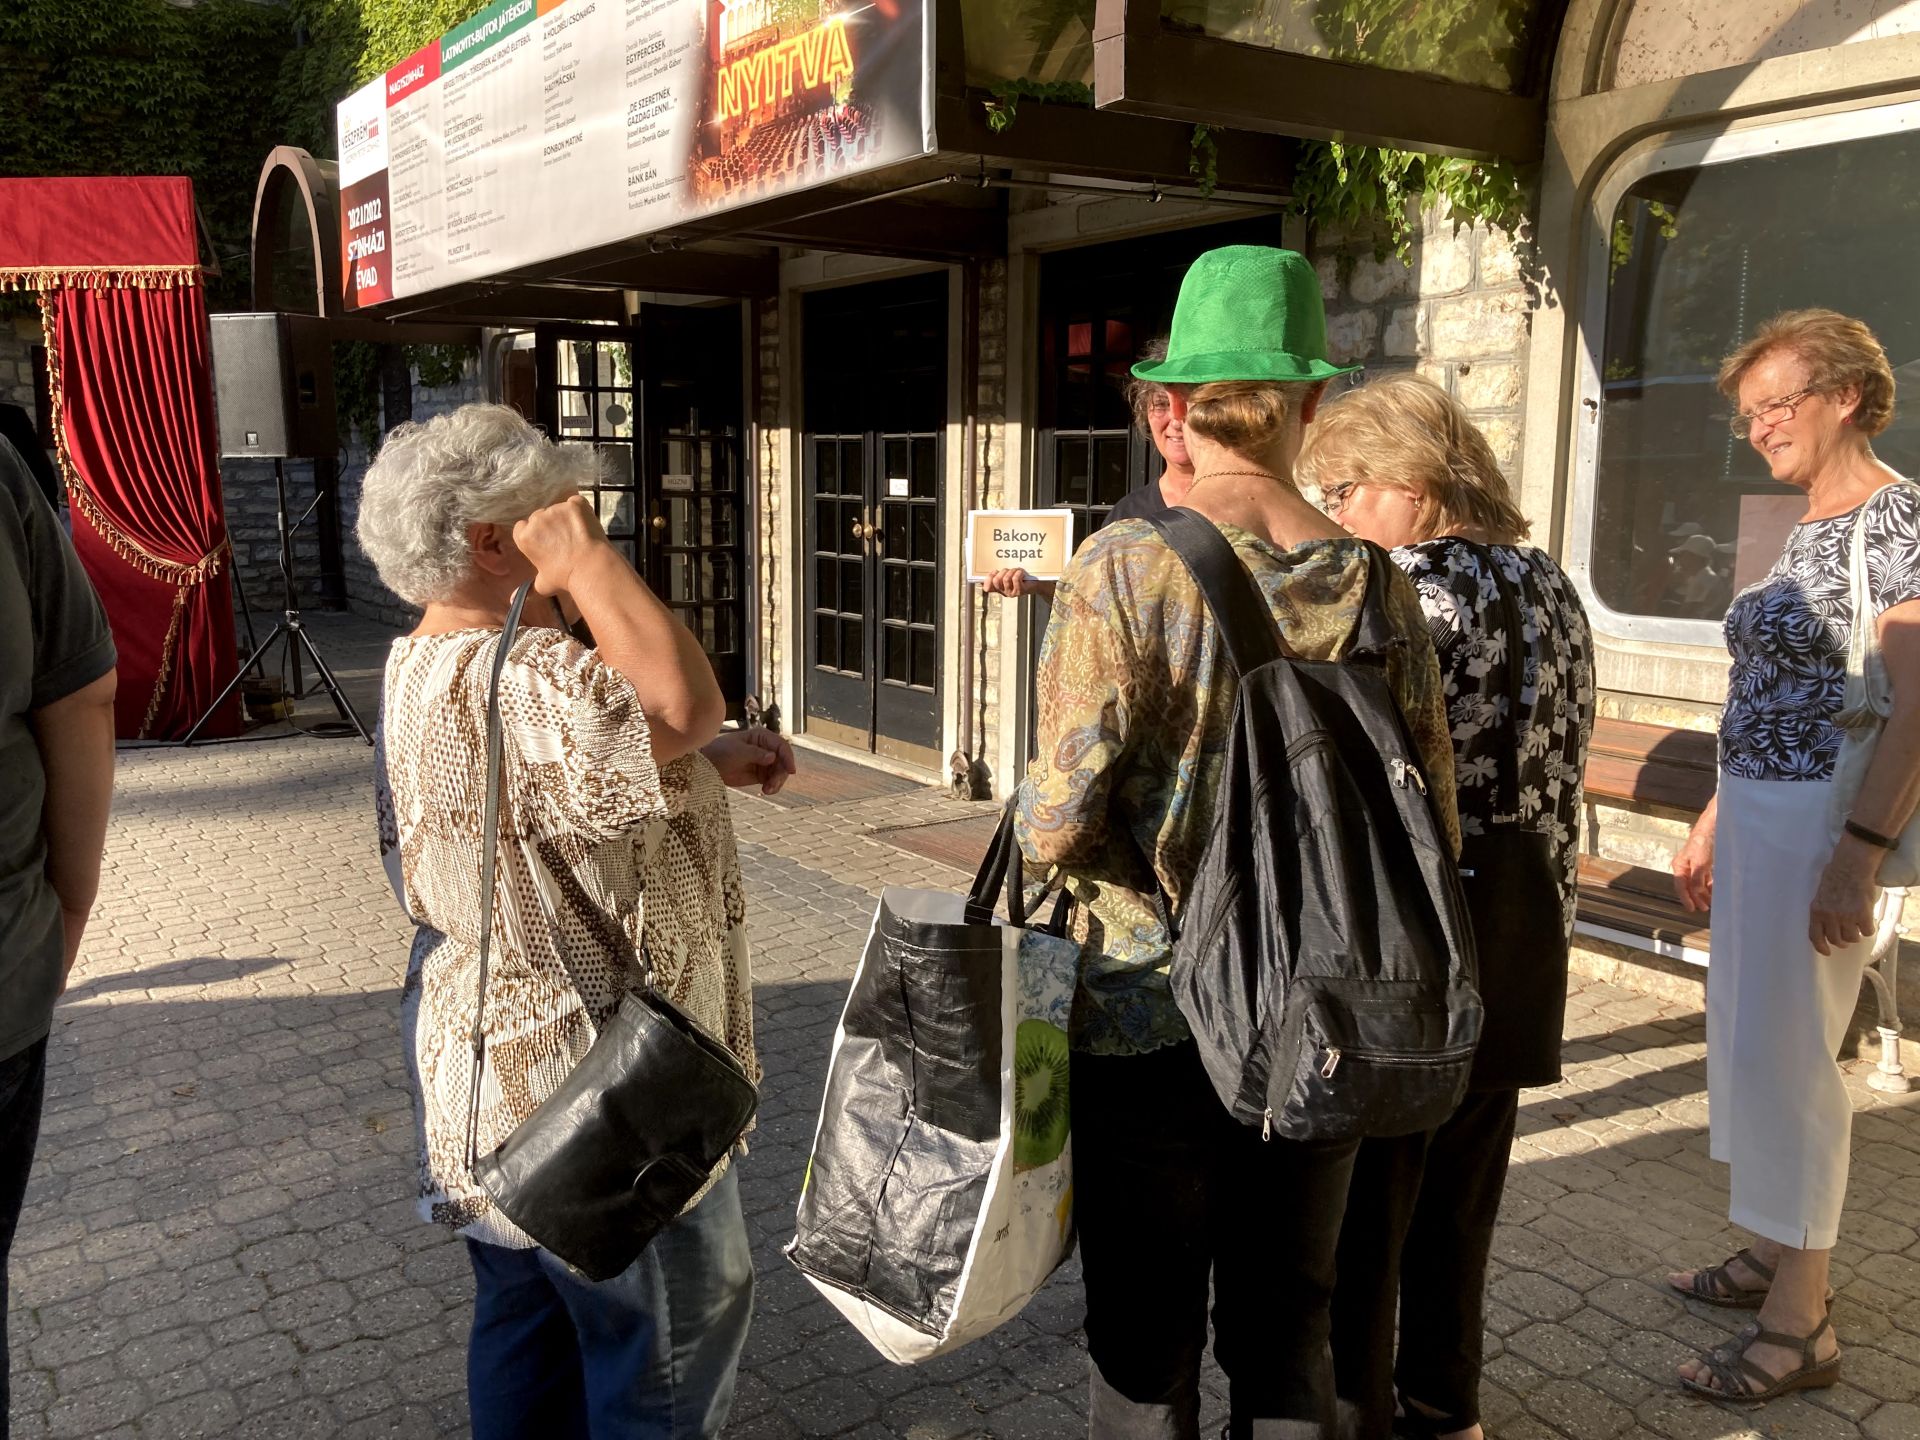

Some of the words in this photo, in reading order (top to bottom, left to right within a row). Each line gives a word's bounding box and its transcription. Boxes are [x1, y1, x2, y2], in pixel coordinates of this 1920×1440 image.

[626, 38, 666, 66] EGYPERCESEK
[718, 18, 855, 122] NYITVA
[638, 86, 671, 110] SZERETNÉK
[627, 108, 651, 127] GAZDAG
[628, 171, 645, 187] BÁNK
[645, 167, 657, 181] BÁN
[348, 228, 385, 262] SZÍNHÁZI
[356, 266, 378, 290] ÉVAD
[993, 529, 1047, 545] Bakony
[995, 547, 1043, 562] csapat
